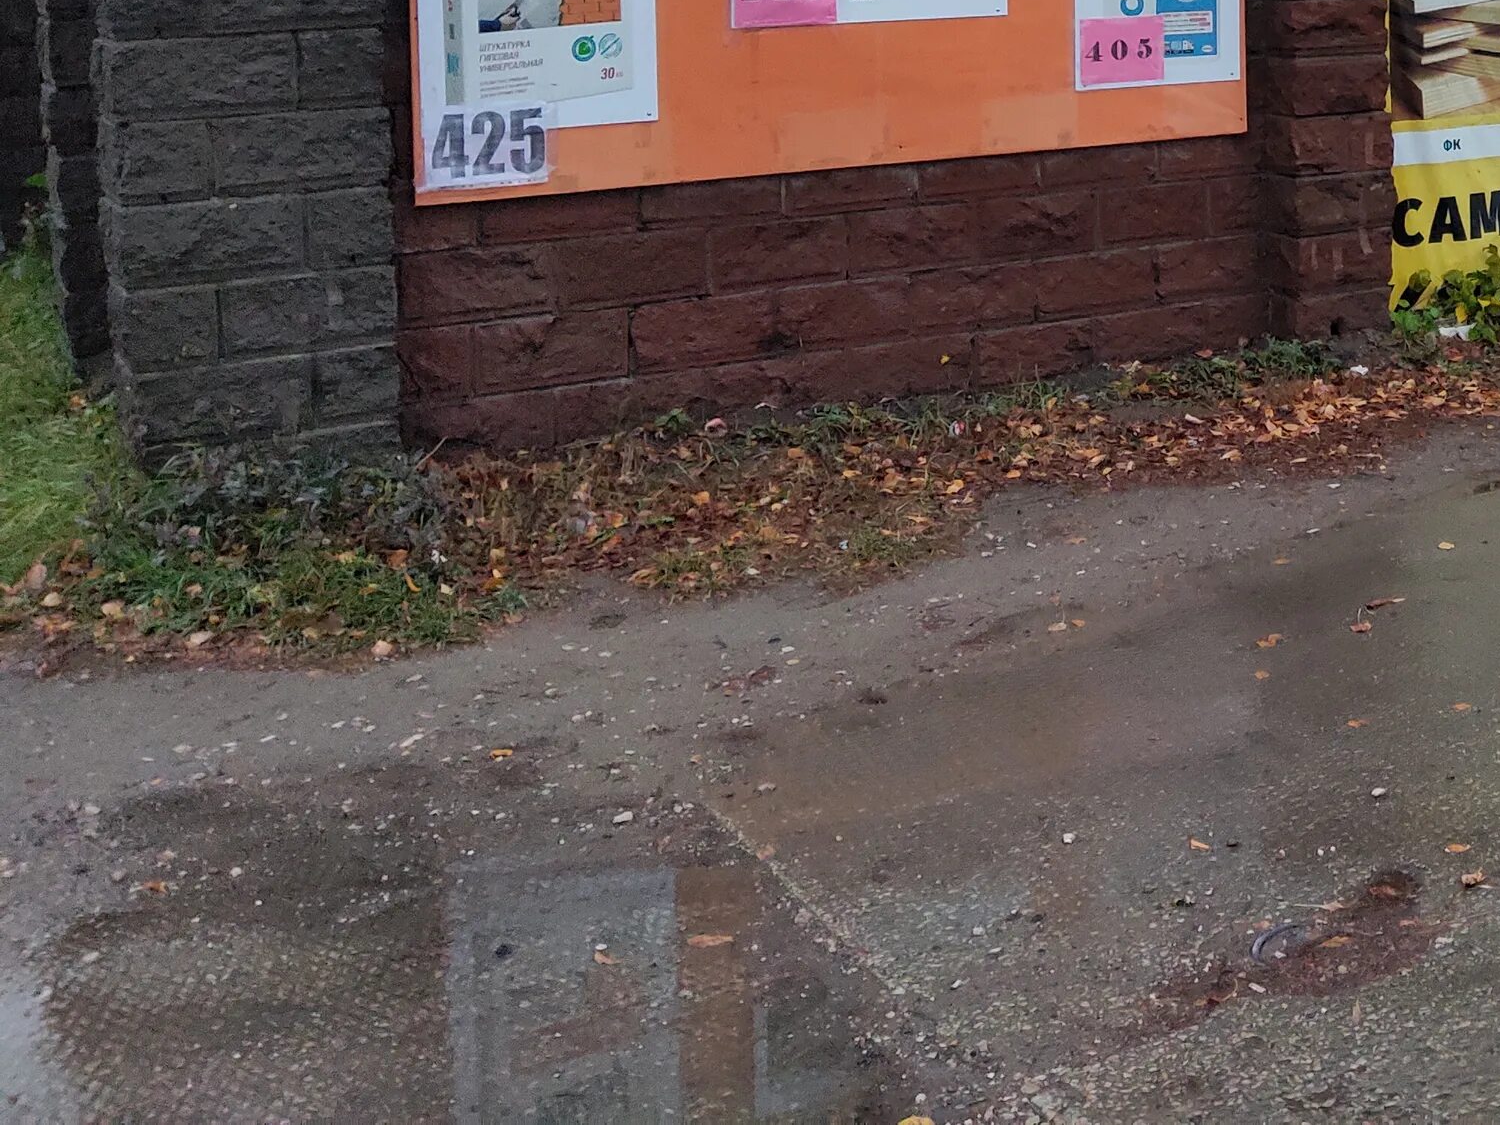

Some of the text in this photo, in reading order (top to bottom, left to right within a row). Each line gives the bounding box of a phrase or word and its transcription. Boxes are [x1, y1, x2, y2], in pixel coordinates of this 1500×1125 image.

[600, 67, 615, 79] 30
[431, 107, 546, 179] 425
[1442, 137, 1461, 152] ФК
